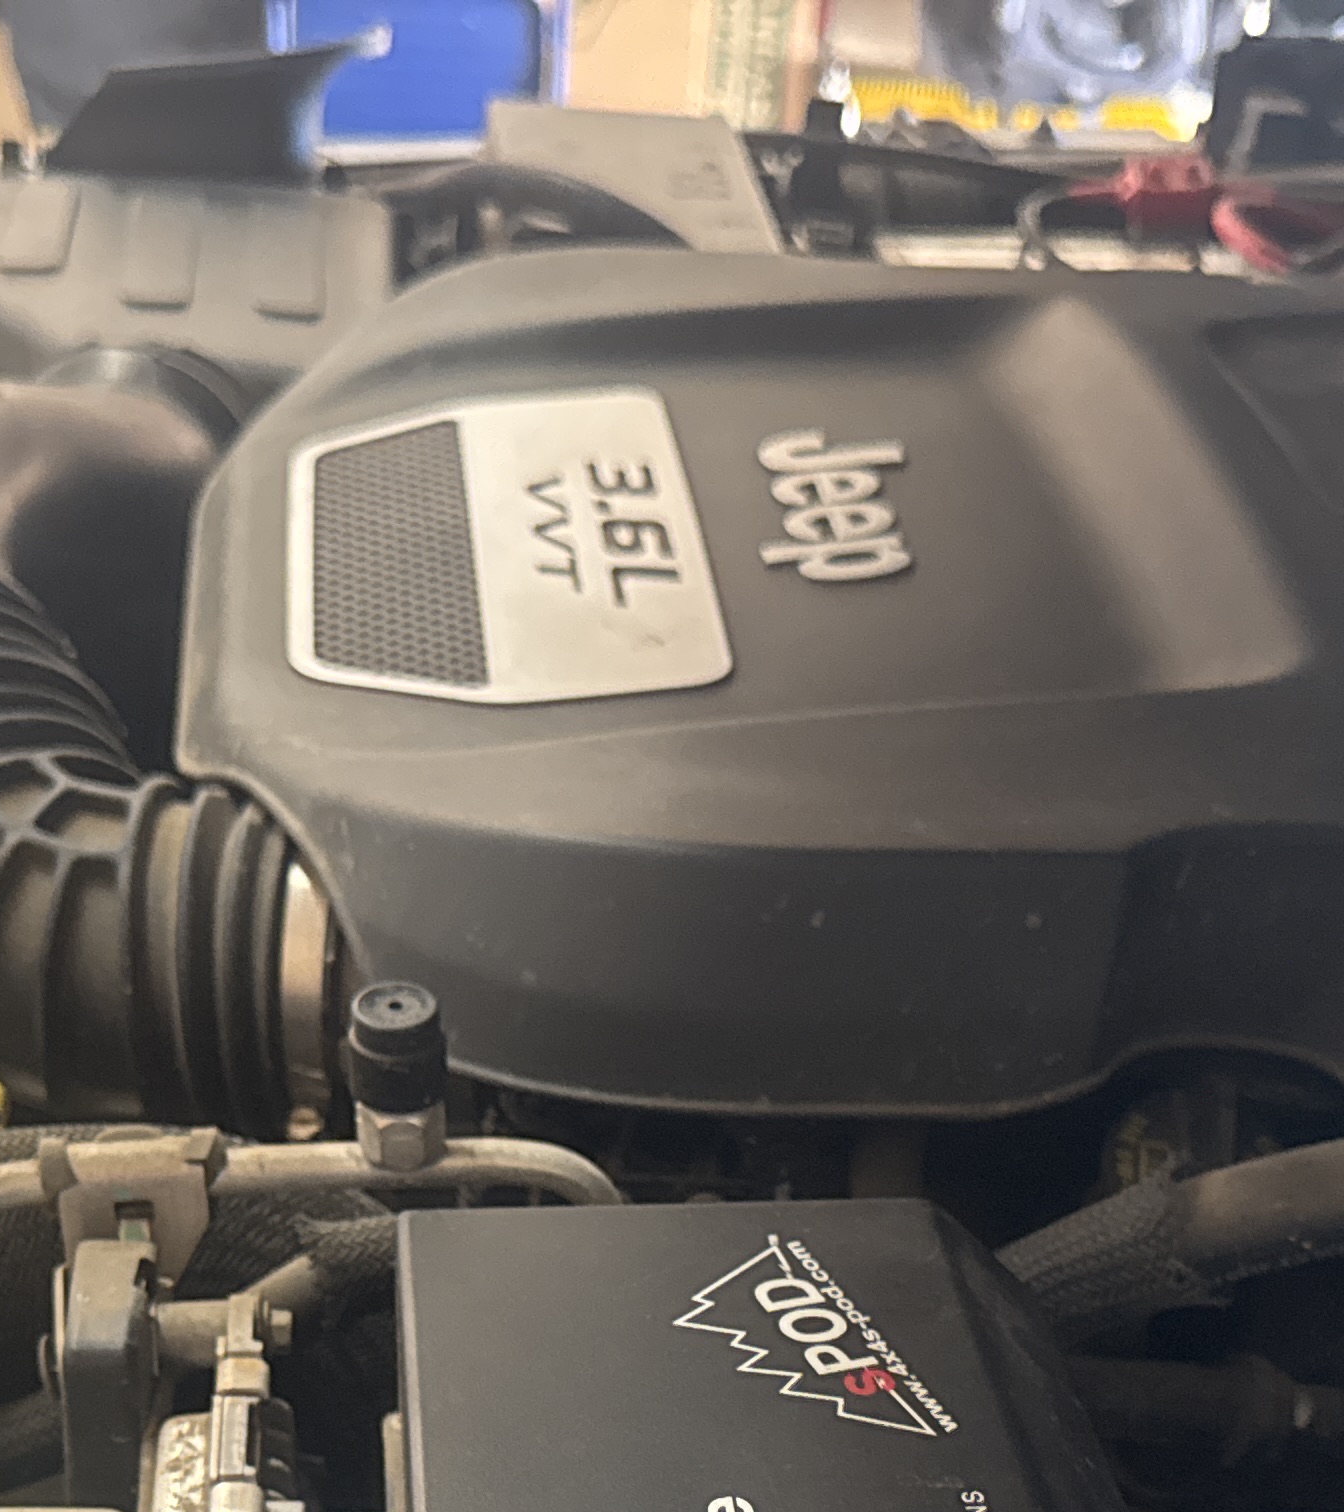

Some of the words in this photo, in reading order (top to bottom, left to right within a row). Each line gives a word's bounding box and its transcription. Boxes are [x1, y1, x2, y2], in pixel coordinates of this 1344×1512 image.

[525, 476, 582, 593] VVT
[584, 455, 682, 608] 3.6L
[756, 428, 913, 582] Jeep
